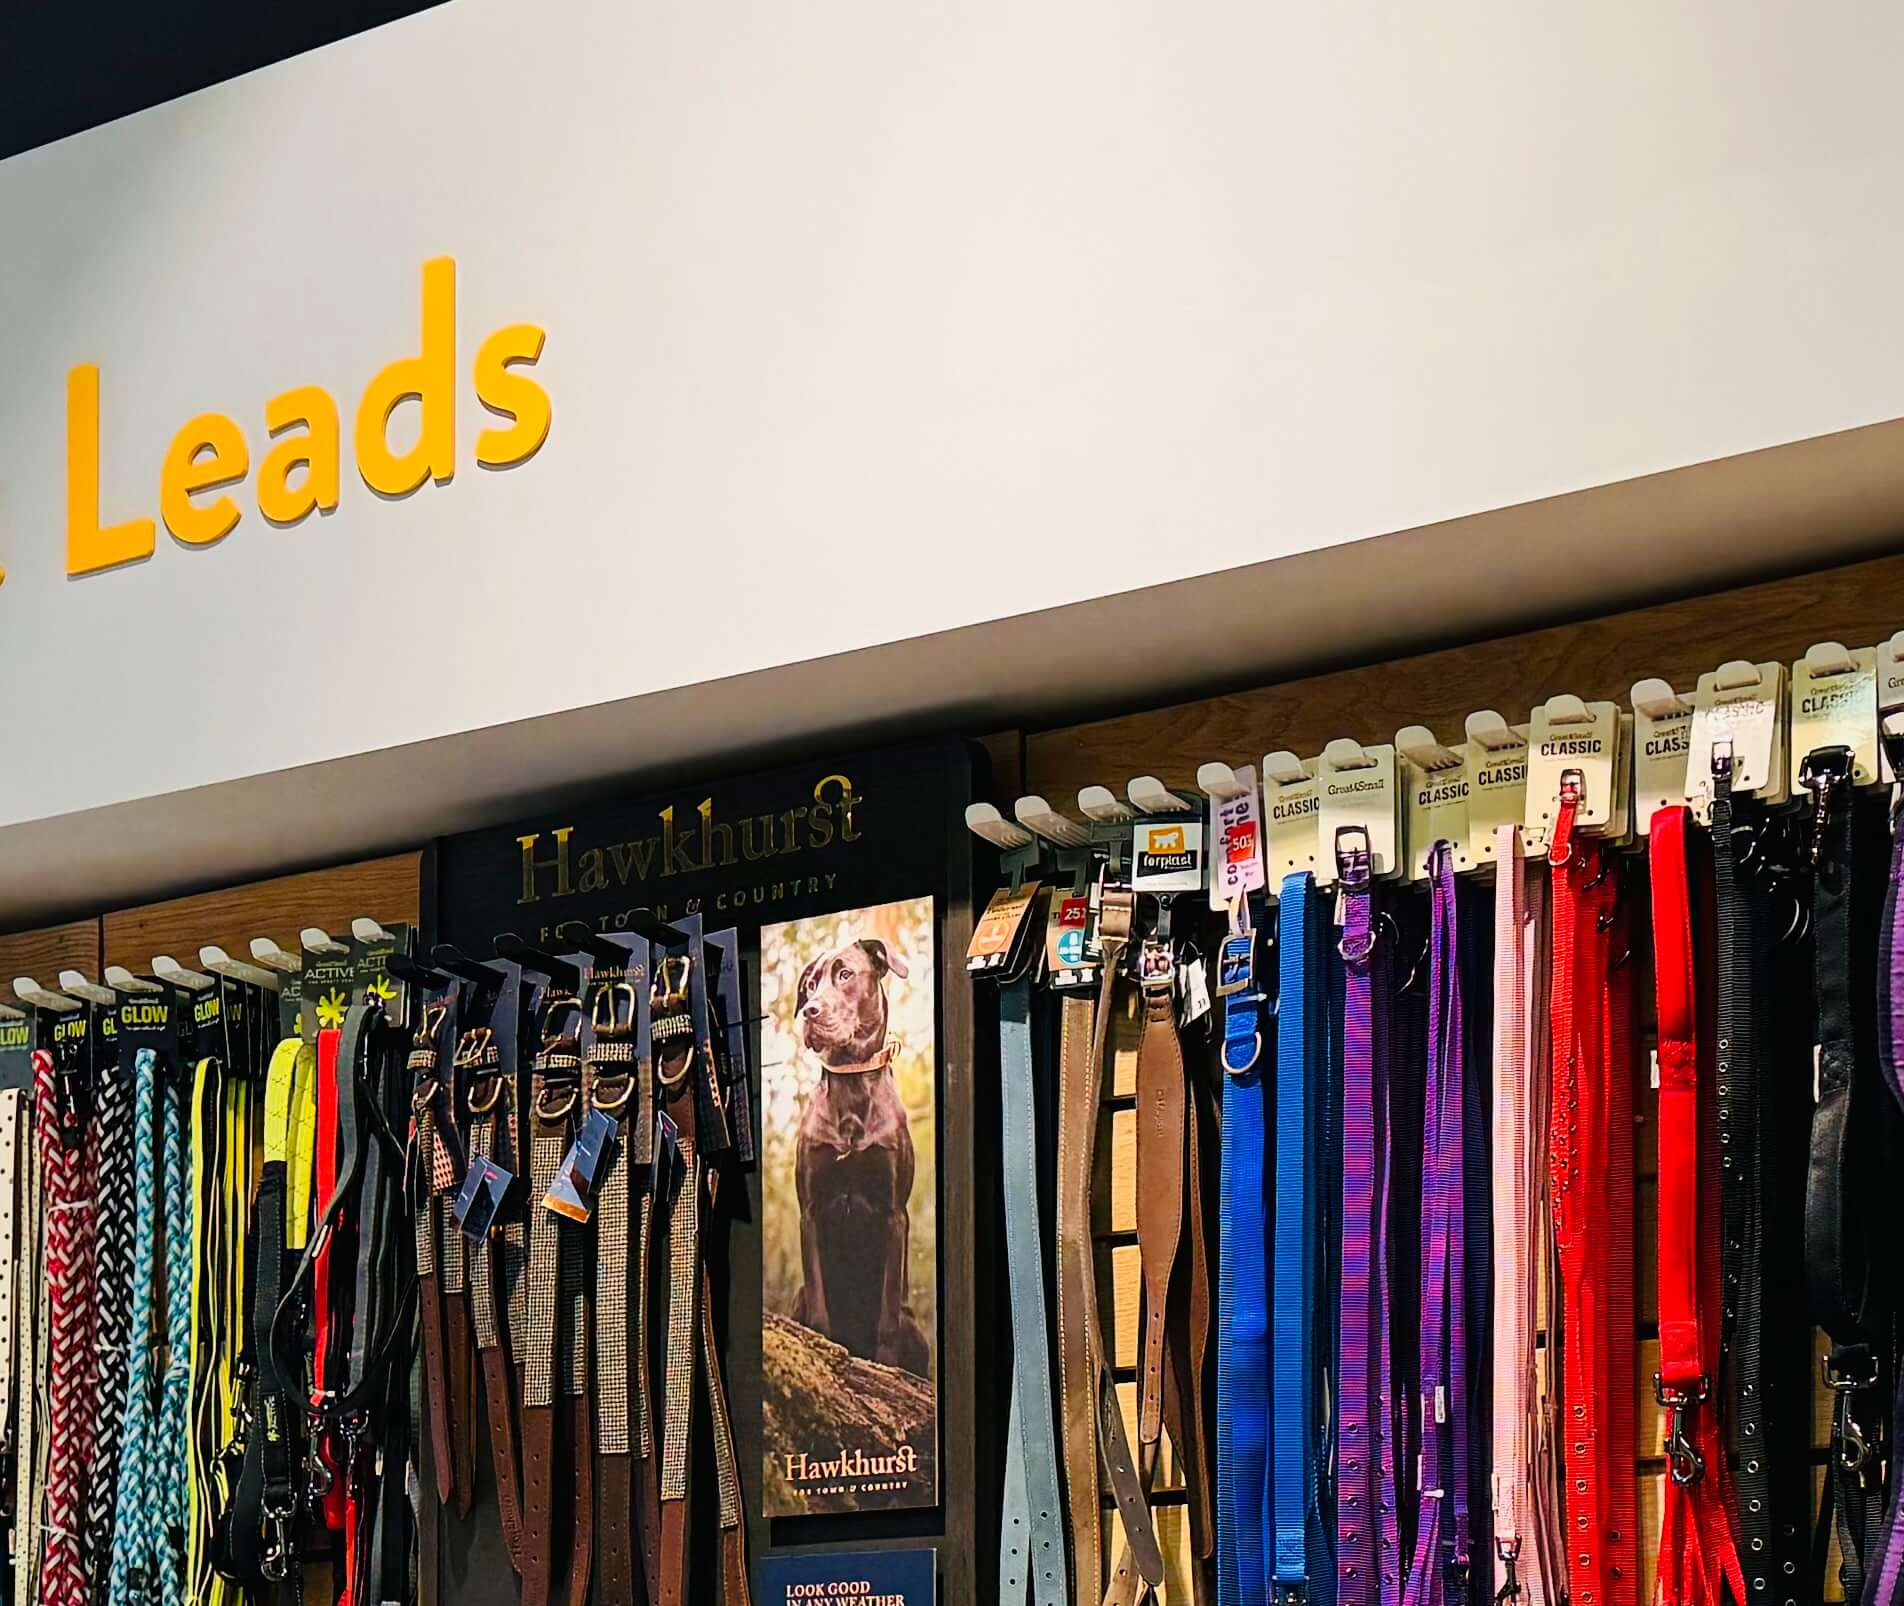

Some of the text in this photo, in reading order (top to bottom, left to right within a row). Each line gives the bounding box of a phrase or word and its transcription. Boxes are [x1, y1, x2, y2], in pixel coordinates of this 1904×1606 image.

[65, 255, 552, 577] Leads
[1540, 740, 1602, 756] CLASSIC
[1418, 783, 1470, 805] CLASSIC
[516, 775, 863, 904] Hawkhurst
[598, 907, 669, 931] TON
[716, 873, 838, 911] COUNTRY
[120, 1006, 168, 1024] GLOW
[784, 1445, 917, 1481] Hawkhurst
[786, 1581, 871, 1598] LOOK GOOD
